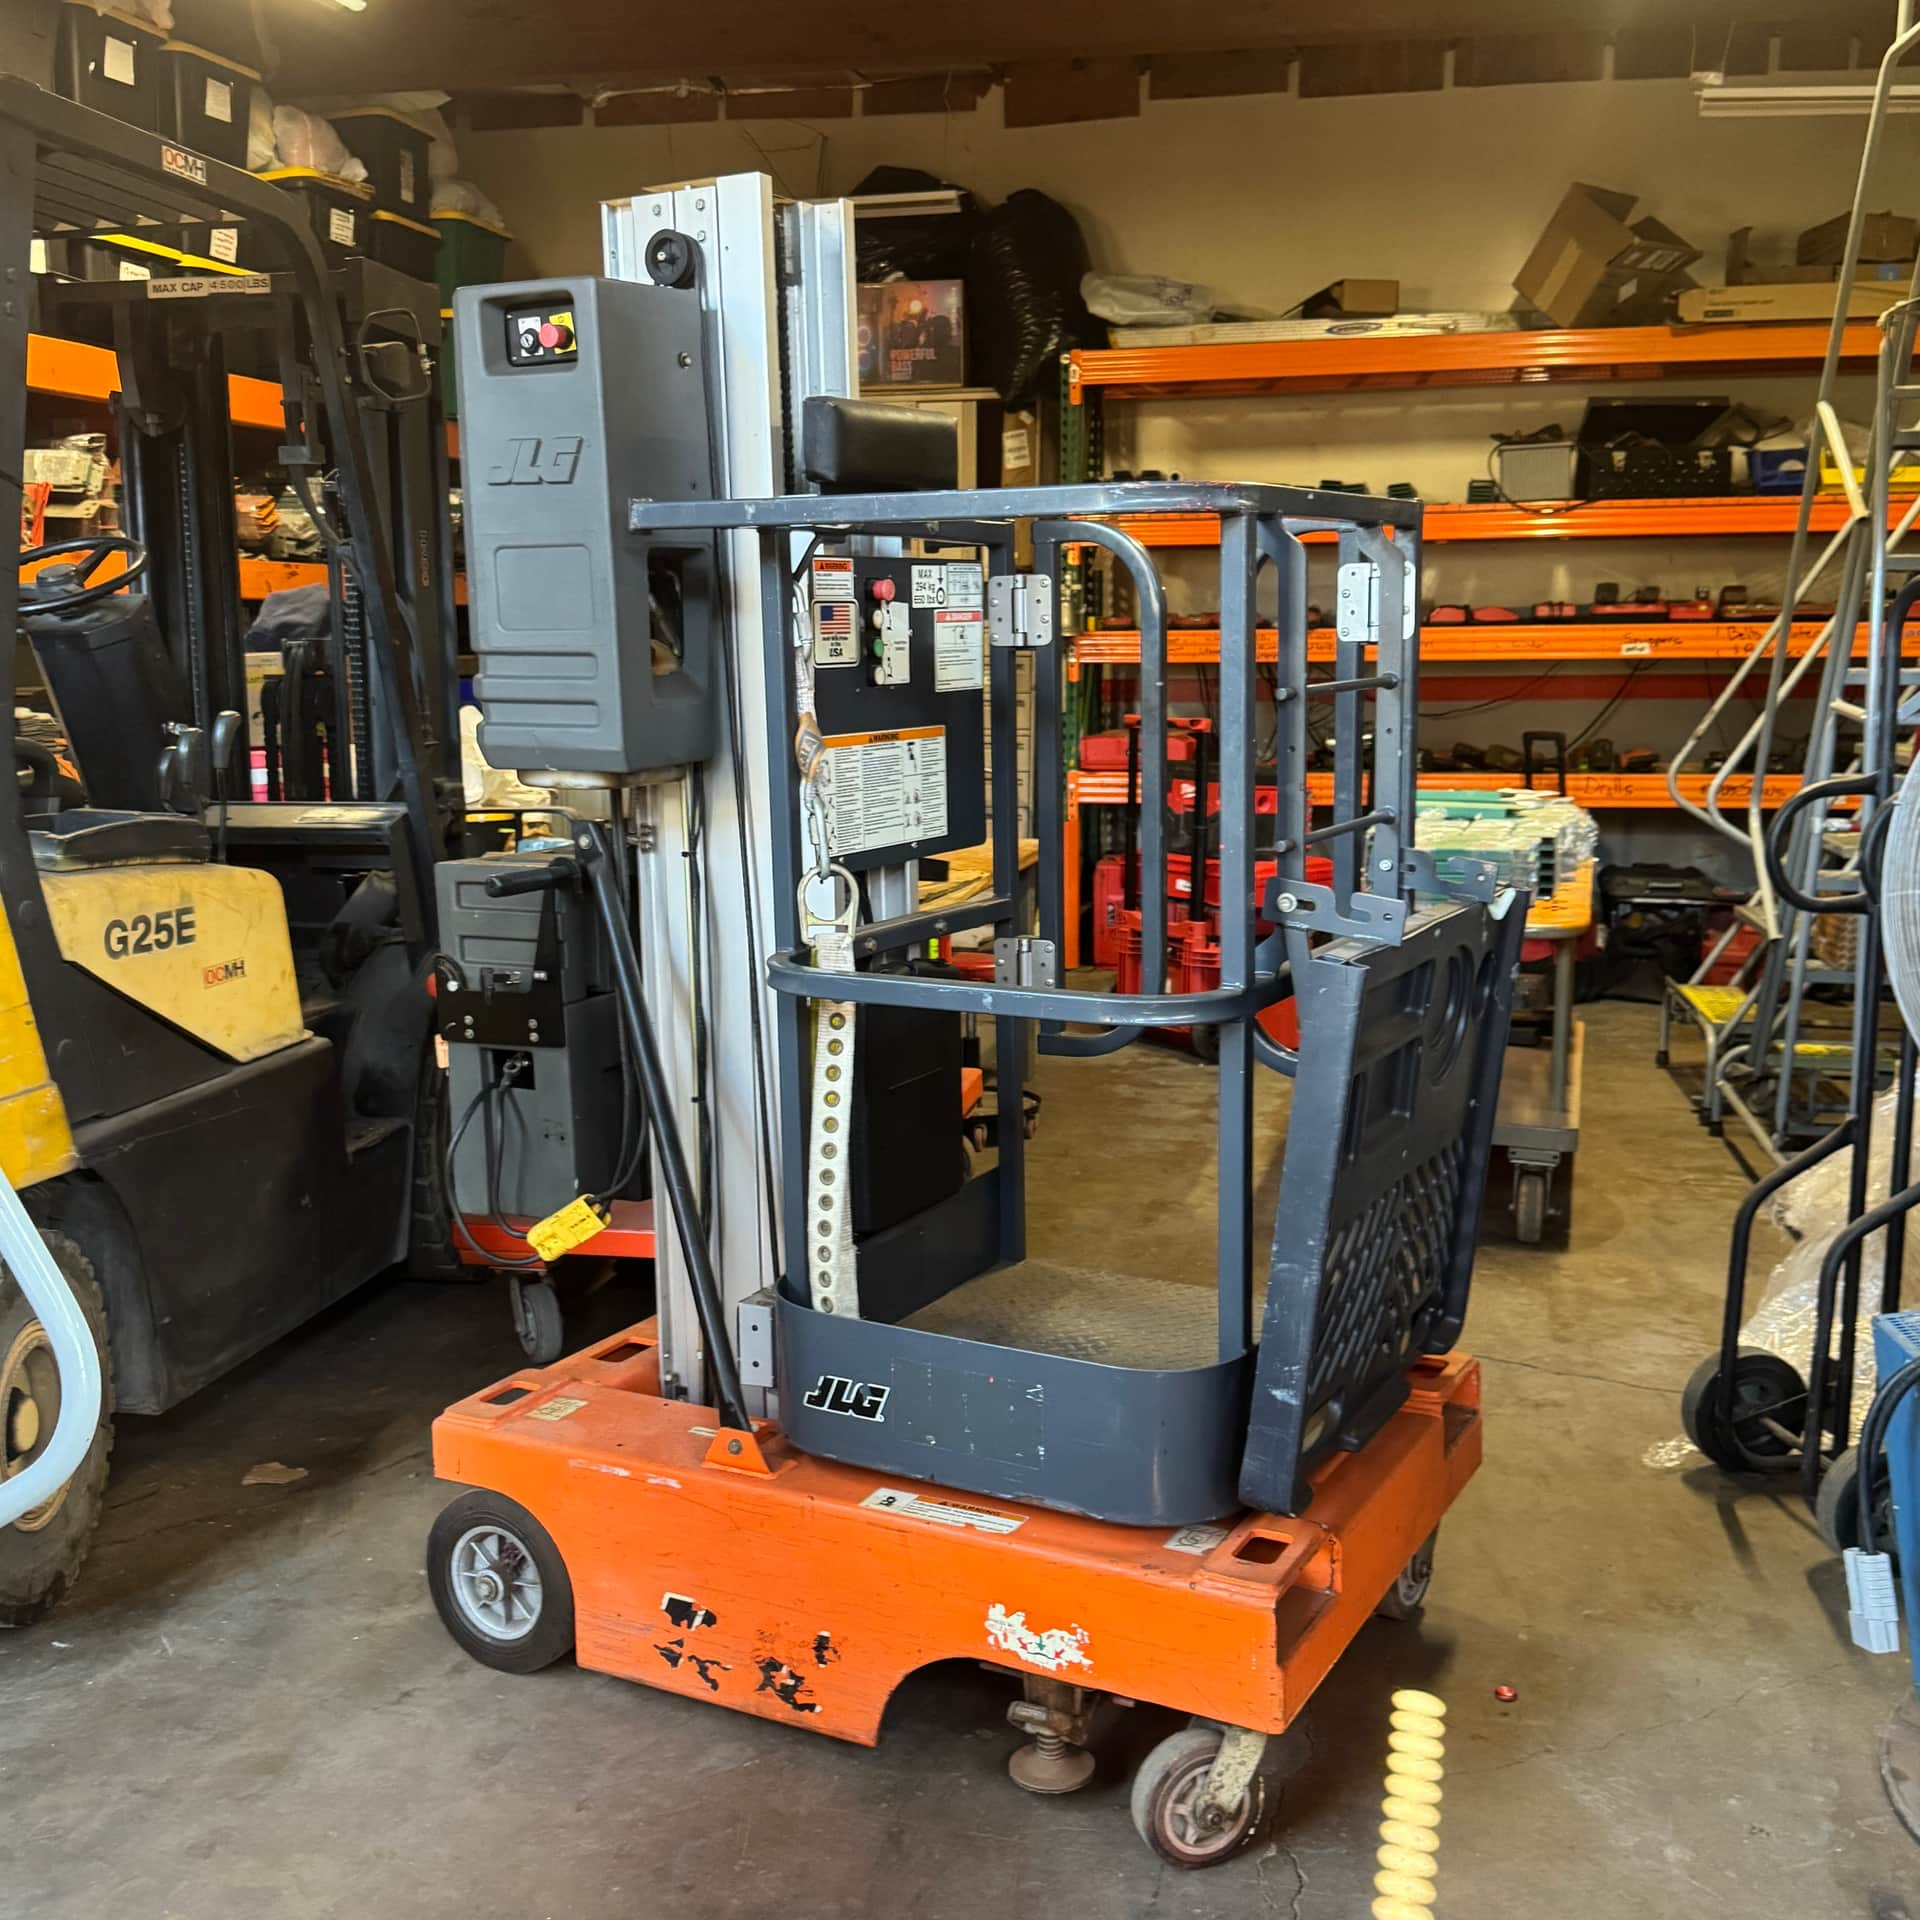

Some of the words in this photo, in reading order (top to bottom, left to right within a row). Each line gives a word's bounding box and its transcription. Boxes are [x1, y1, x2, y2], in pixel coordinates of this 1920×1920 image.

[163, 148, 207, 182] OCMH
[152, 281, 177, 294] MAX
[181, 280, 204, 293] CAP
[209, 278, 244, 290] 4500
[246, 276, 269, 289] LBS
[488, 436, 584, 486] JLG
[104, 906, 197, 960] G25E
[206, 959, 246, 985] OCMH
[804, 1376, 889, 1421] JLG
